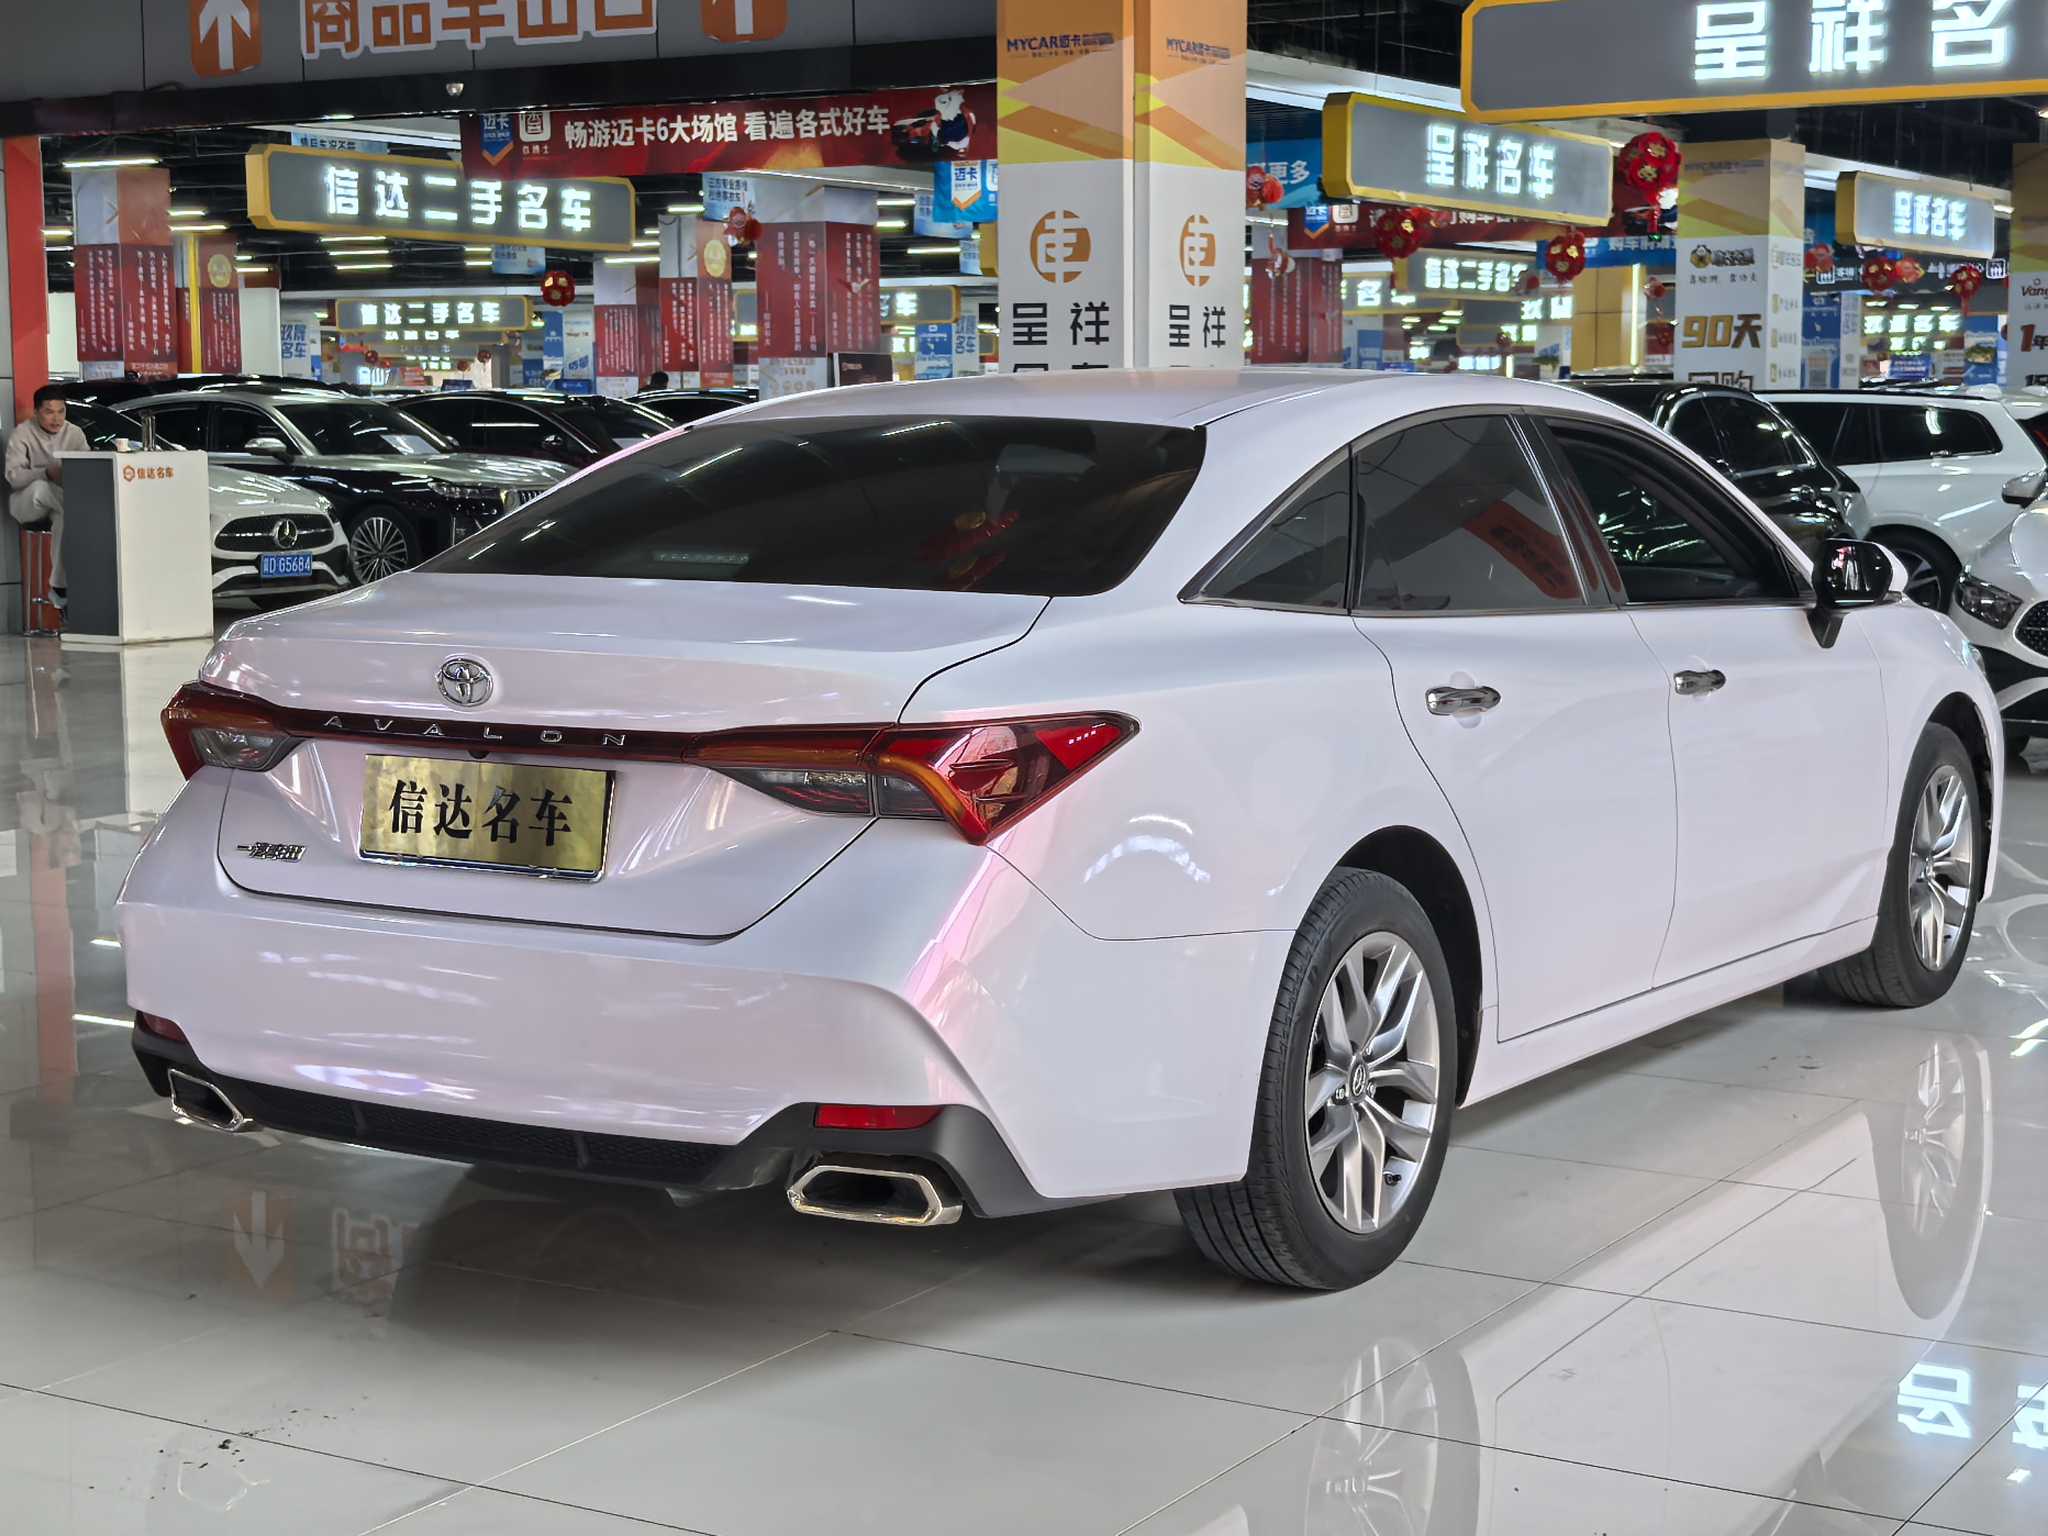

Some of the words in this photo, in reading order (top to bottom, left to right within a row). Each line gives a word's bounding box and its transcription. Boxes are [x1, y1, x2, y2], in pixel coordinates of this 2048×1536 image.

[564, 112, 738, 149] 畅游迈卡6大场馆
[744, 105, 890, 142] 看遍各式好车
[1425, 122, 1557, 199] 呈祥名车
[325, 166, 592, 232] 信达二手名车
[1894, 190, 1968, 241] 呈祥名车
[361, 302, 500, 325] 信达二手名车
[1012, 301, 1110, 346] 呈祥
[1169, 304, 1226, 348] 呈祥
[1681, 313, 1762, 349] 90天
[137, 466, 175, 480] 信达名车
[323, 714, 627, 747] AVALON
[388, 779, 573, 847] 信达名车
